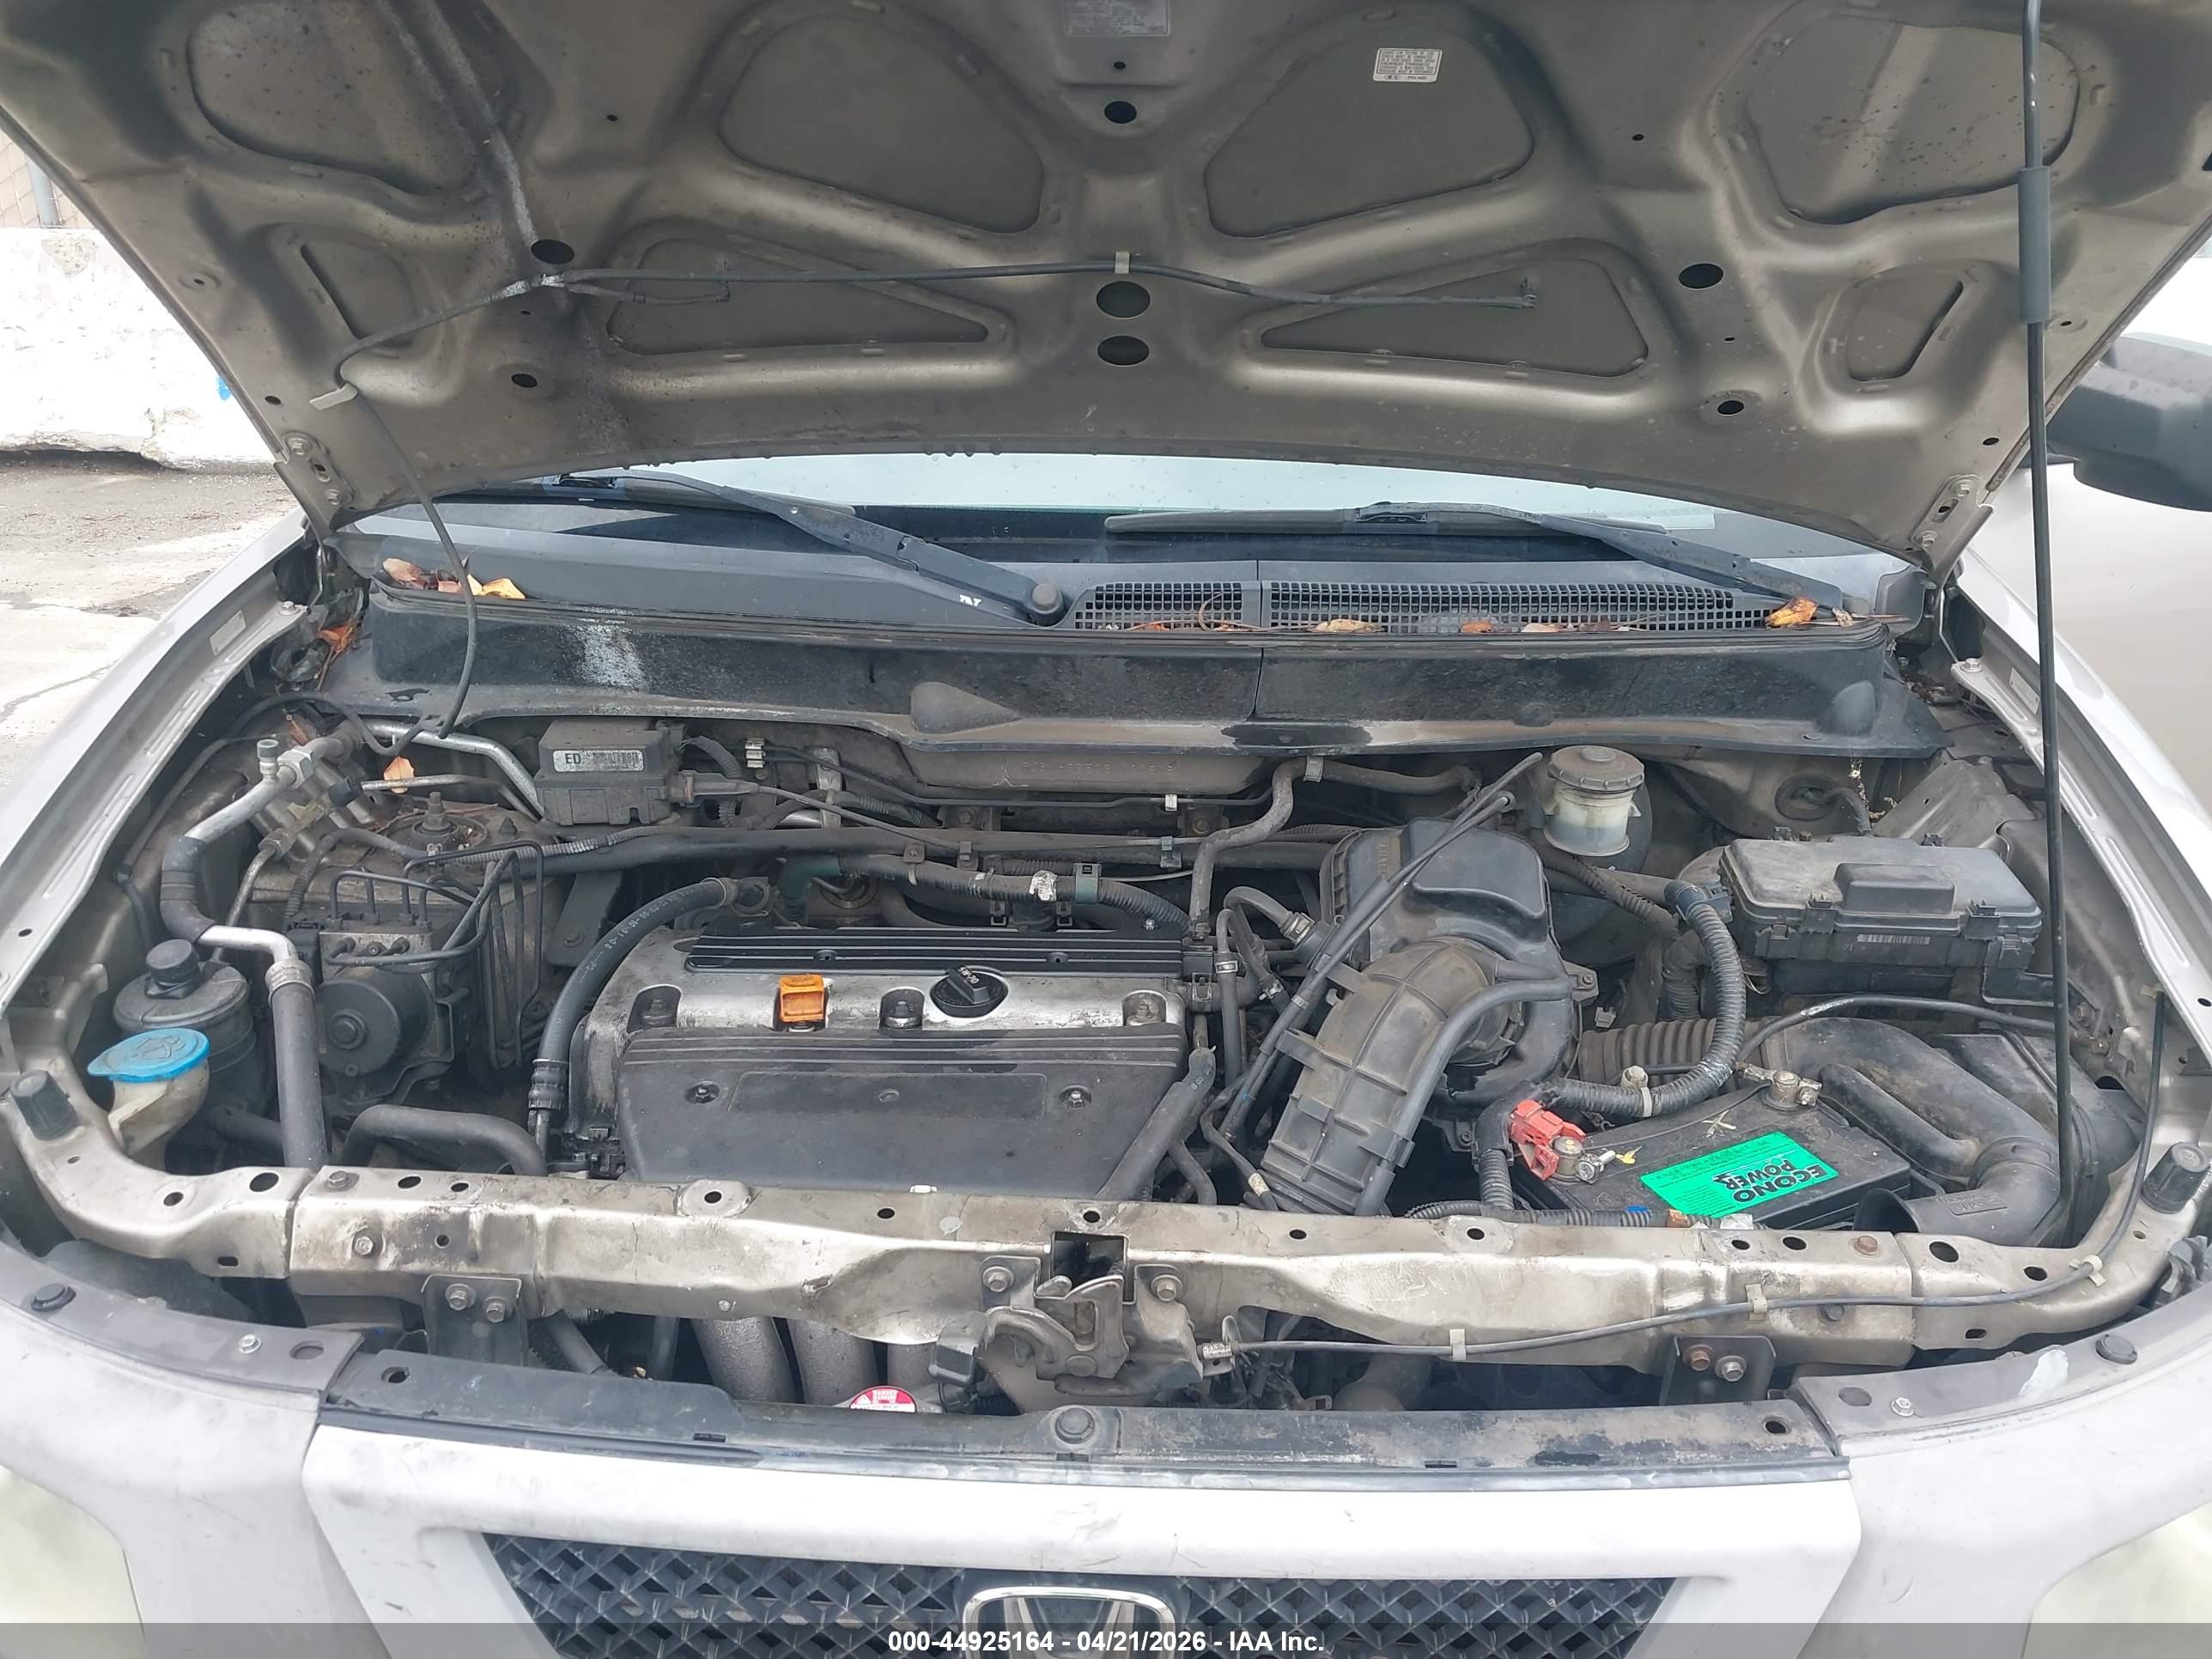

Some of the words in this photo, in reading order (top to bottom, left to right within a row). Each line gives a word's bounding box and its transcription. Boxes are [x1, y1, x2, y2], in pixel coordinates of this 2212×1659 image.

[565, 753, 581, 764] ED
[1713, 1159, 1796, 1190] POWER
[1733, 1164, 1828, 1203] ECONO
